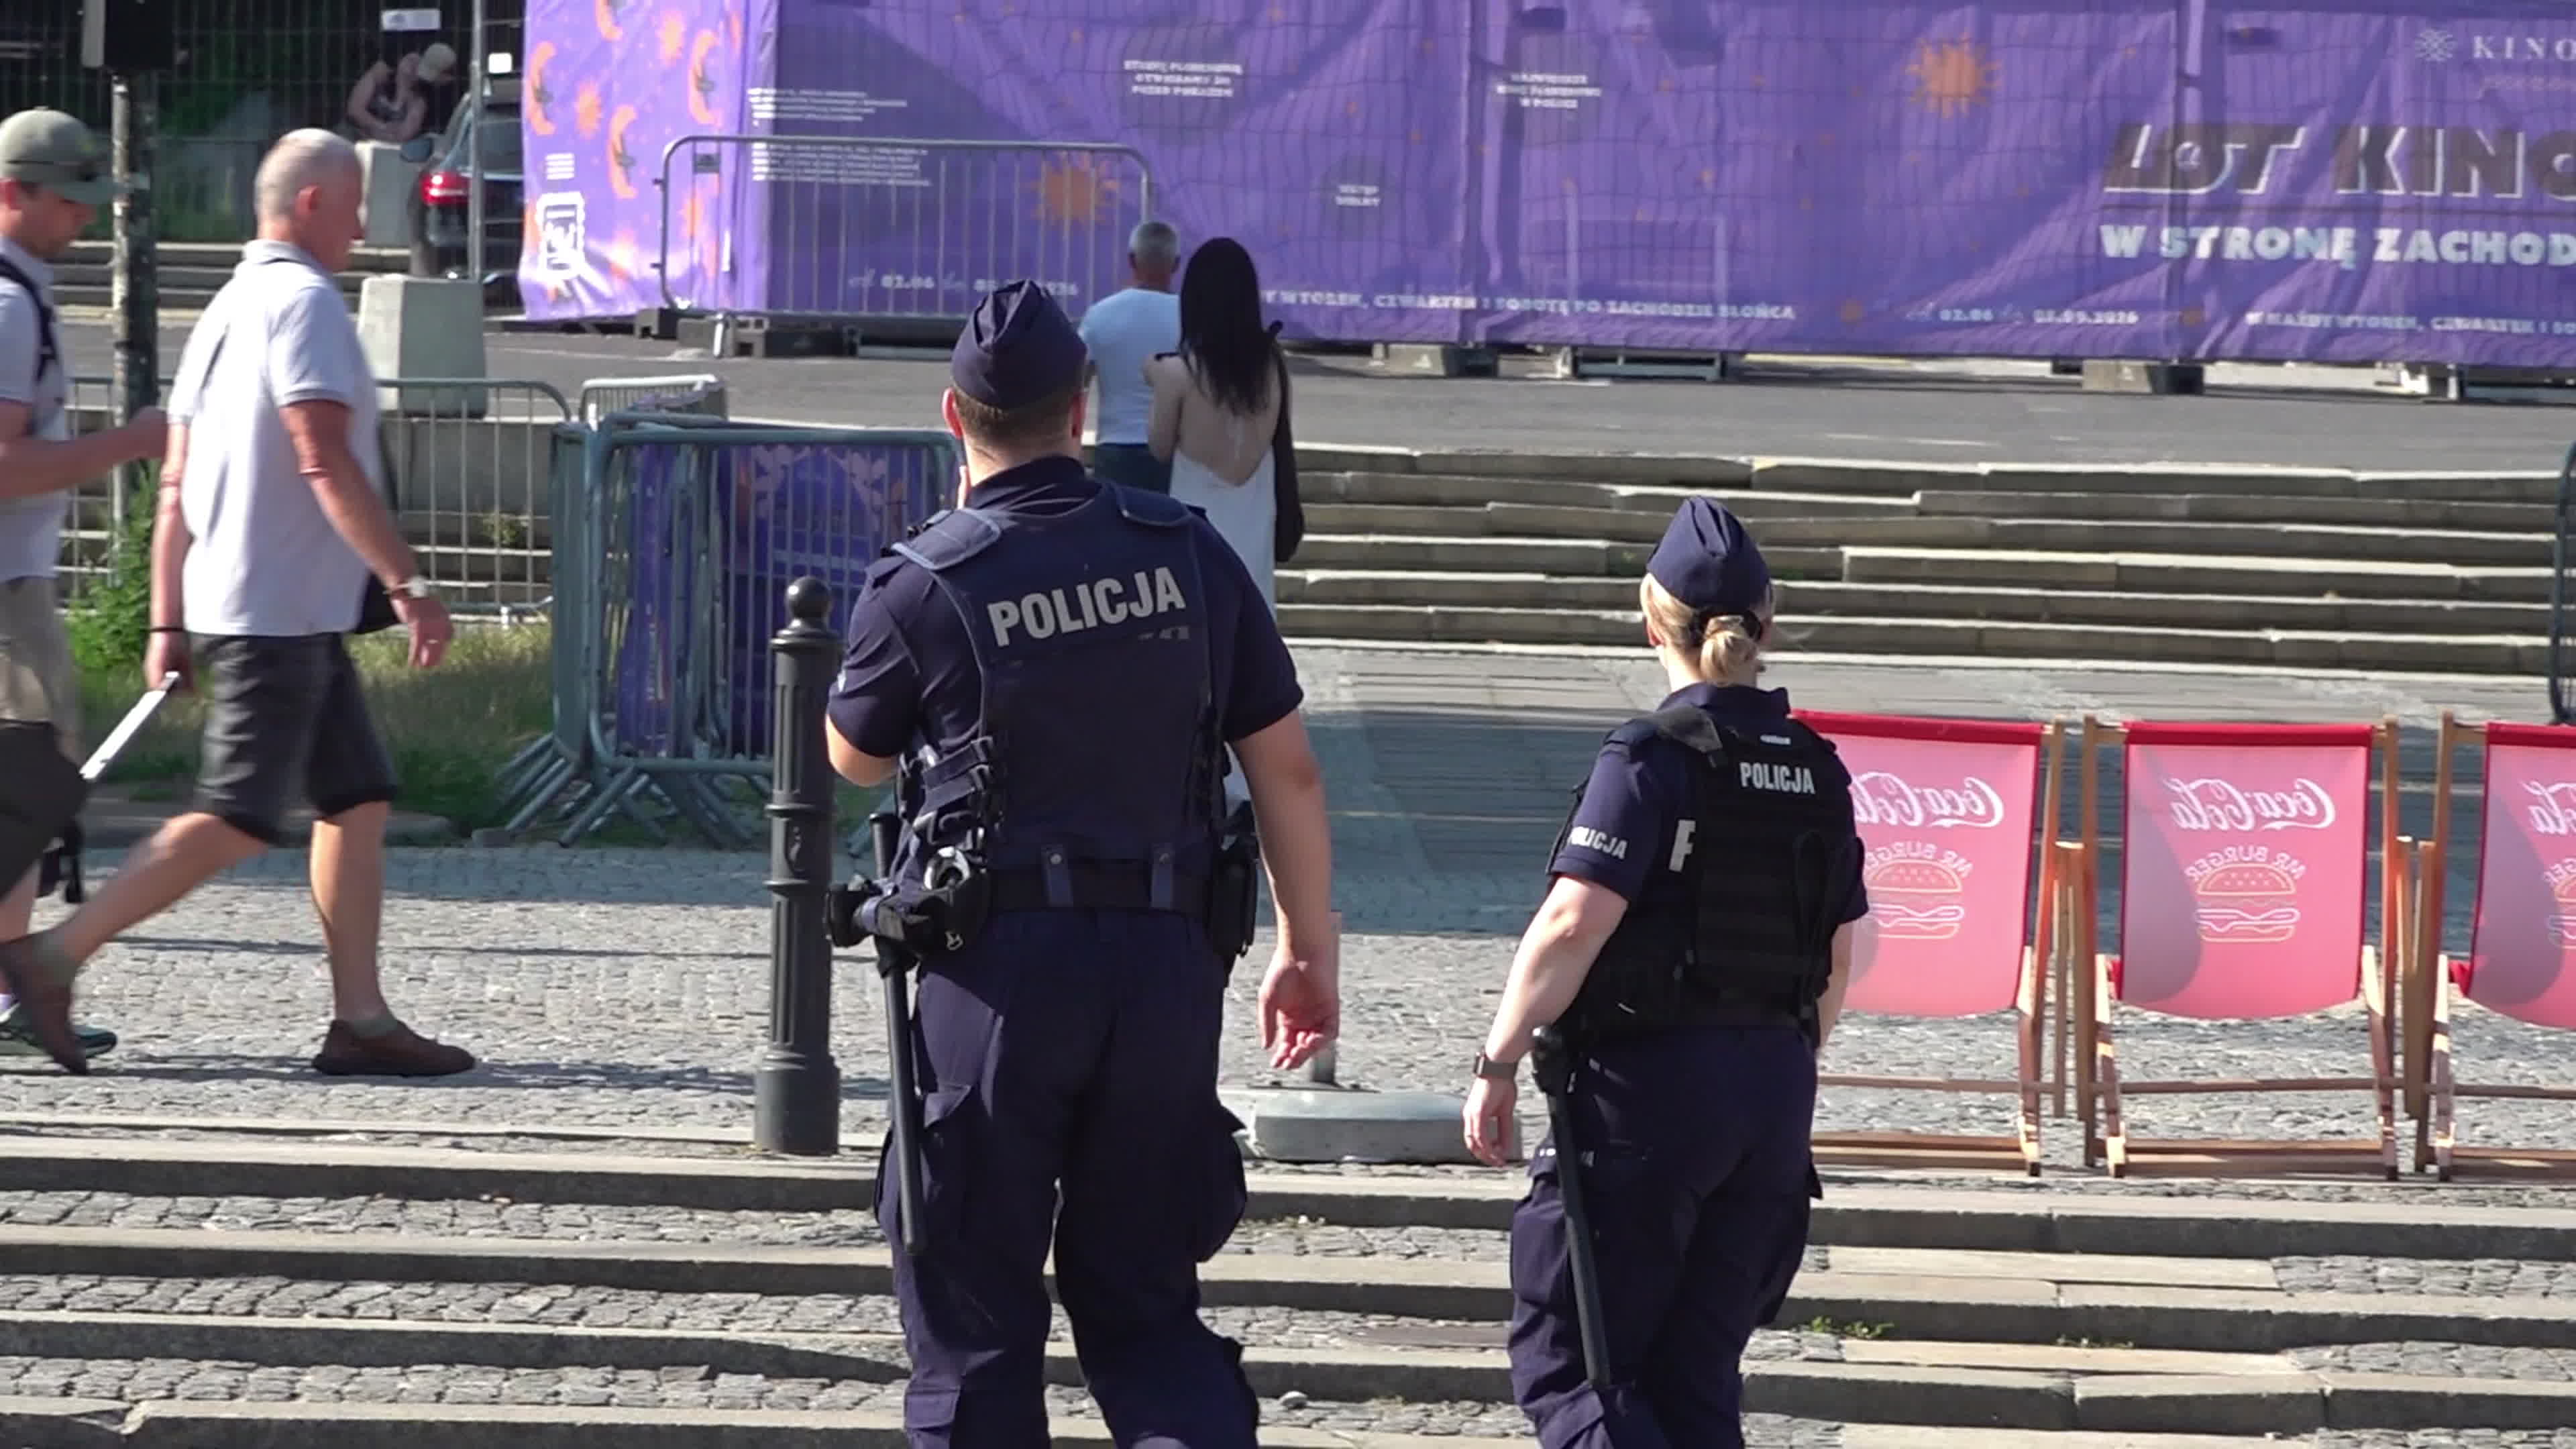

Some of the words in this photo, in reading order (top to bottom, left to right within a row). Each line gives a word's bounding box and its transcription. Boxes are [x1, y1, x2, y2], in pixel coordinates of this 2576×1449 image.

[2100, 224, 2147, 258] W
[2159, 226, 2358, 270] STRONĘ
[2373, 227, 2576, 266] ZACHOD
[987, 566, 1187, 648] POLICJA
[1739, 761, 1815, 795] POLICJA
